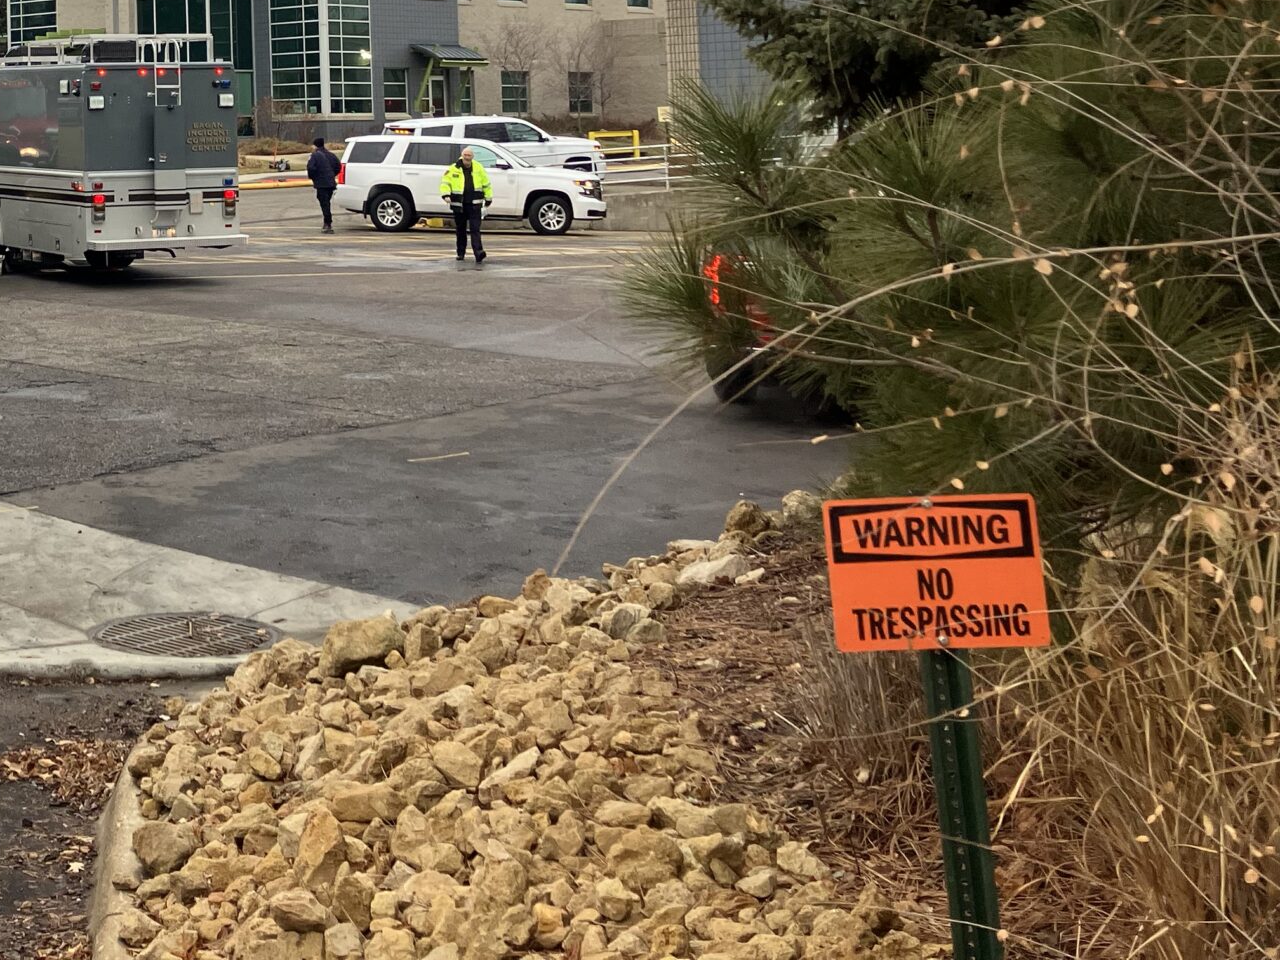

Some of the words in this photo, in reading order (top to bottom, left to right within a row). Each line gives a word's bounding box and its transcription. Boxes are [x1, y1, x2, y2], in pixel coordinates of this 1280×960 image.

[187, 129, 230, 137] INCIDENT
[192, 122, 224, 130] EAGAN
[852, 514, 1010, 548] WARNING
[917, 568, 954, 600] NO
[852, 604, 1031, 640] TRESPASSING
